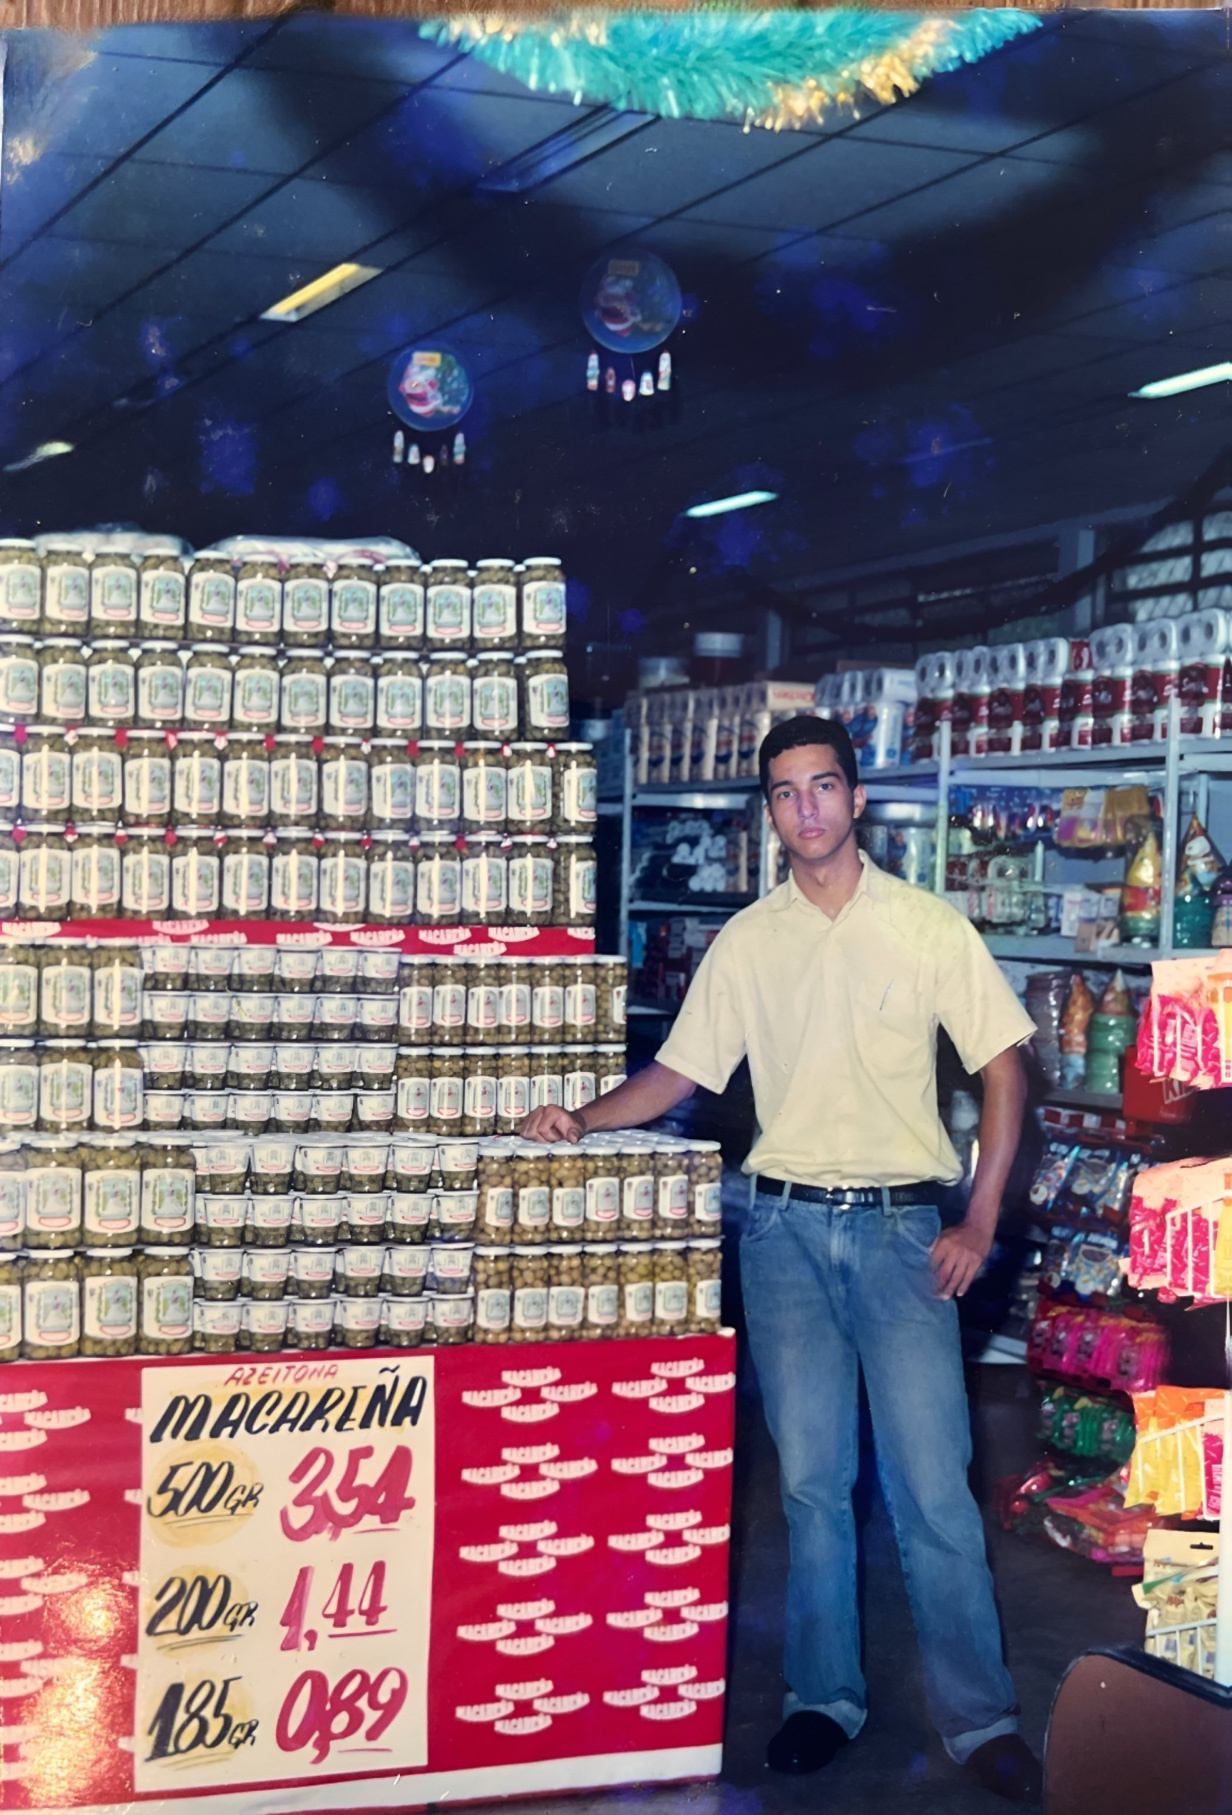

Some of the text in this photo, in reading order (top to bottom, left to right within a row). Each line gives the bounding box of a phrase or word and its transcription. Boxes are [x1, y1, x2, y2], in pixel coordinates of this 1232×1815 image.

[150, 1365, 427, 1443] MACAREÑA
[224, 1364, 338, 1387] AZEITONA
[280, 1560, 388, 1652] 1,44
[275, 1667, 408, 1765] 0,89
